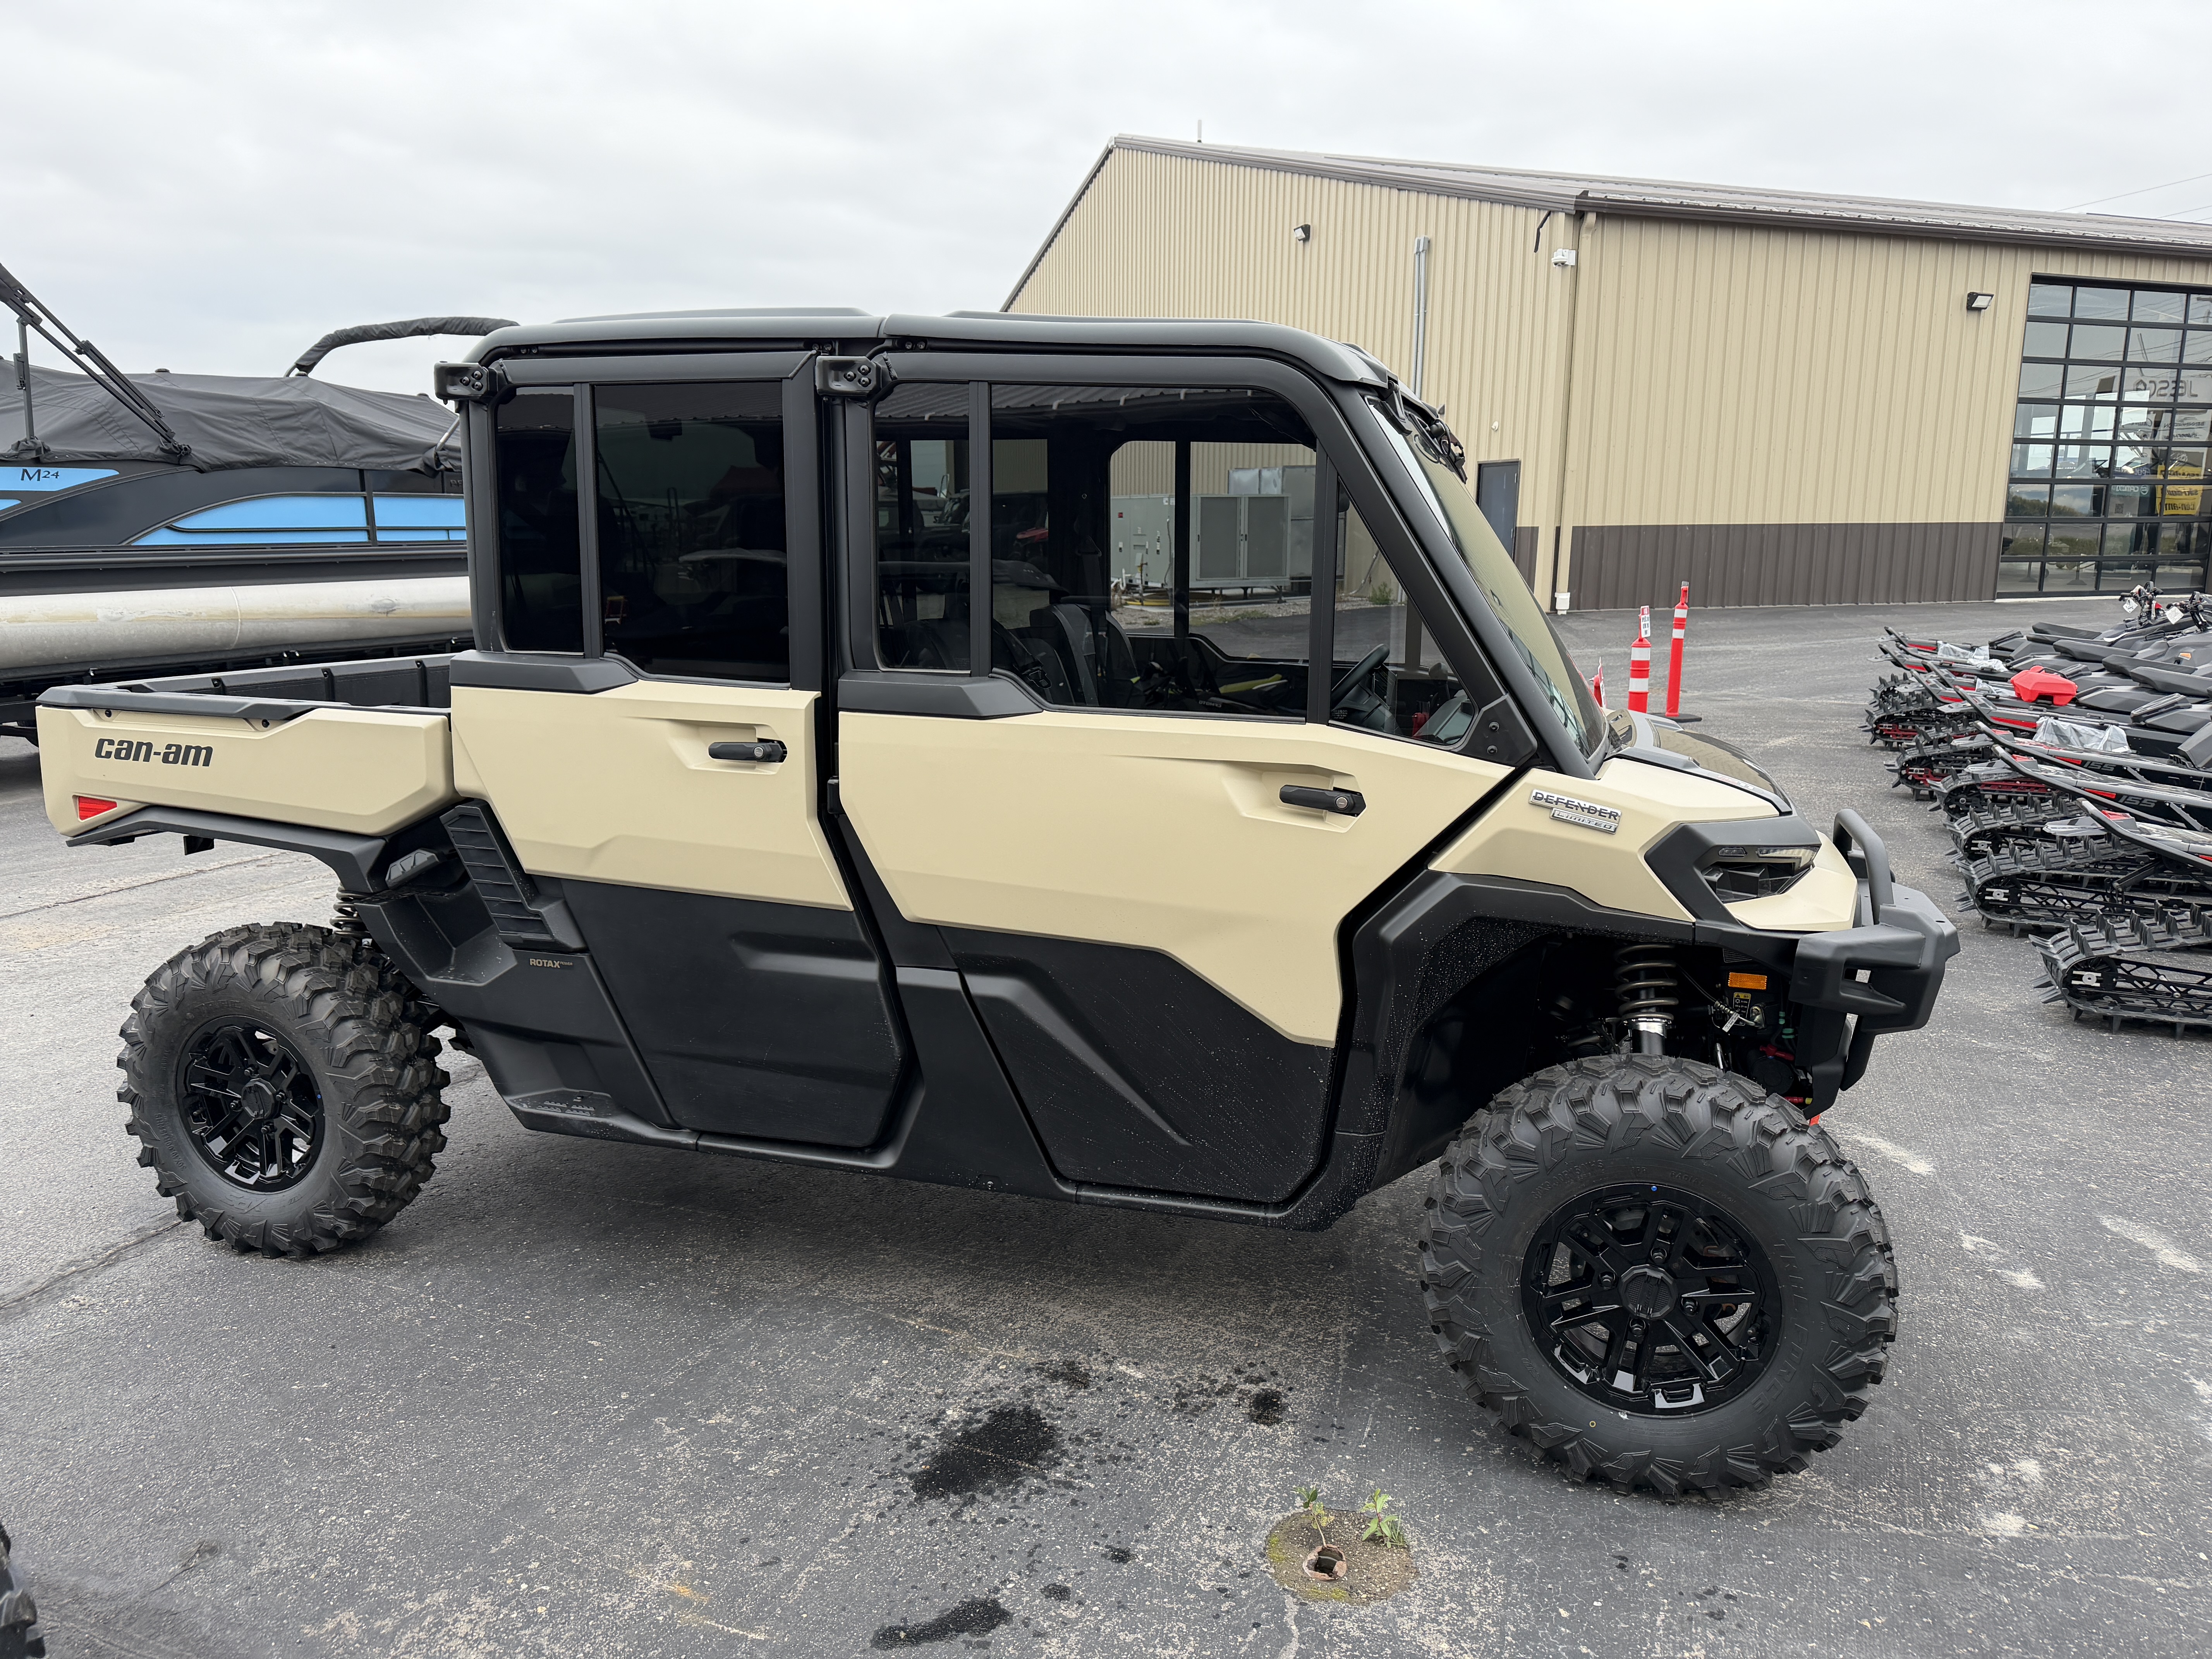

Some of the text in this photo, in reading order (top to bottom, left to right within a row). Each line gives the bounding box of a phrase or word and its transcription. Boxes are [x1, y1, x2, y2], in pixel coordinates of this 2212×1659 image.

[21, 468, 60, 482] M24
[95, 738, 213, 767] can-am
[2083, 760, 2116, 772] 155
[1533, 792, 1620, 821] DEFENDER
[2119, 795, 2158, 808] 155
[1556, 811, 1613, 830] LIMITED
[529, 958, 560, 969] ROTAX
